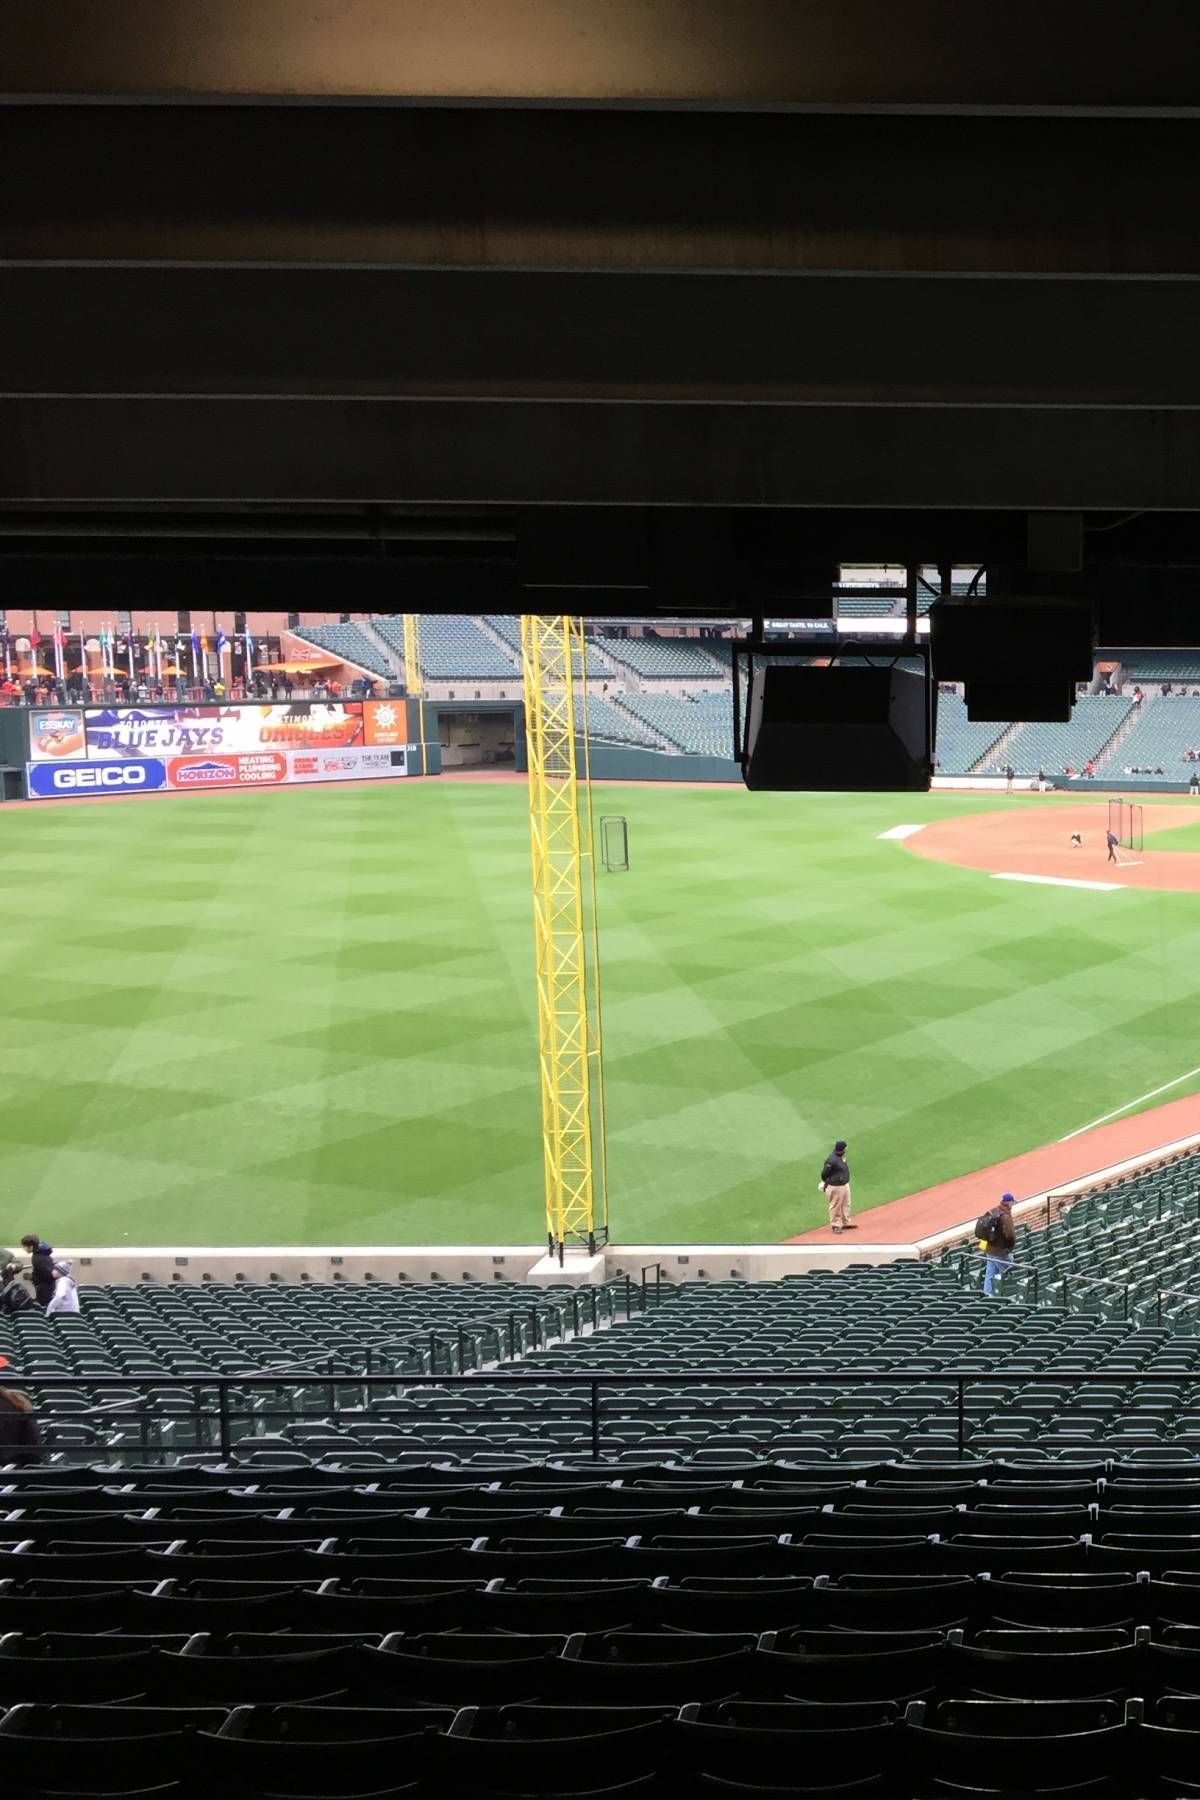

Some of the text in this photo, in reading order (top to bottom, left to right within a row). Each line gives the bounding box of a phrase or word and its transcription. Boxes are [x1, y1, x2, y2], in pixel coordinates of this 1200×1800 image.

[40, 719, 75, 730] ESSKAY
[97, 727, 224, 749] BLUE JAYS
[238, 755, 275, 765] HEATING
[238, 763, 281, 773] PLUMBING
[54, 765, 146, 789] GEICO
[178, 769, 235, 780] HORIZON
[240, 771, 276, 781] COOLING
